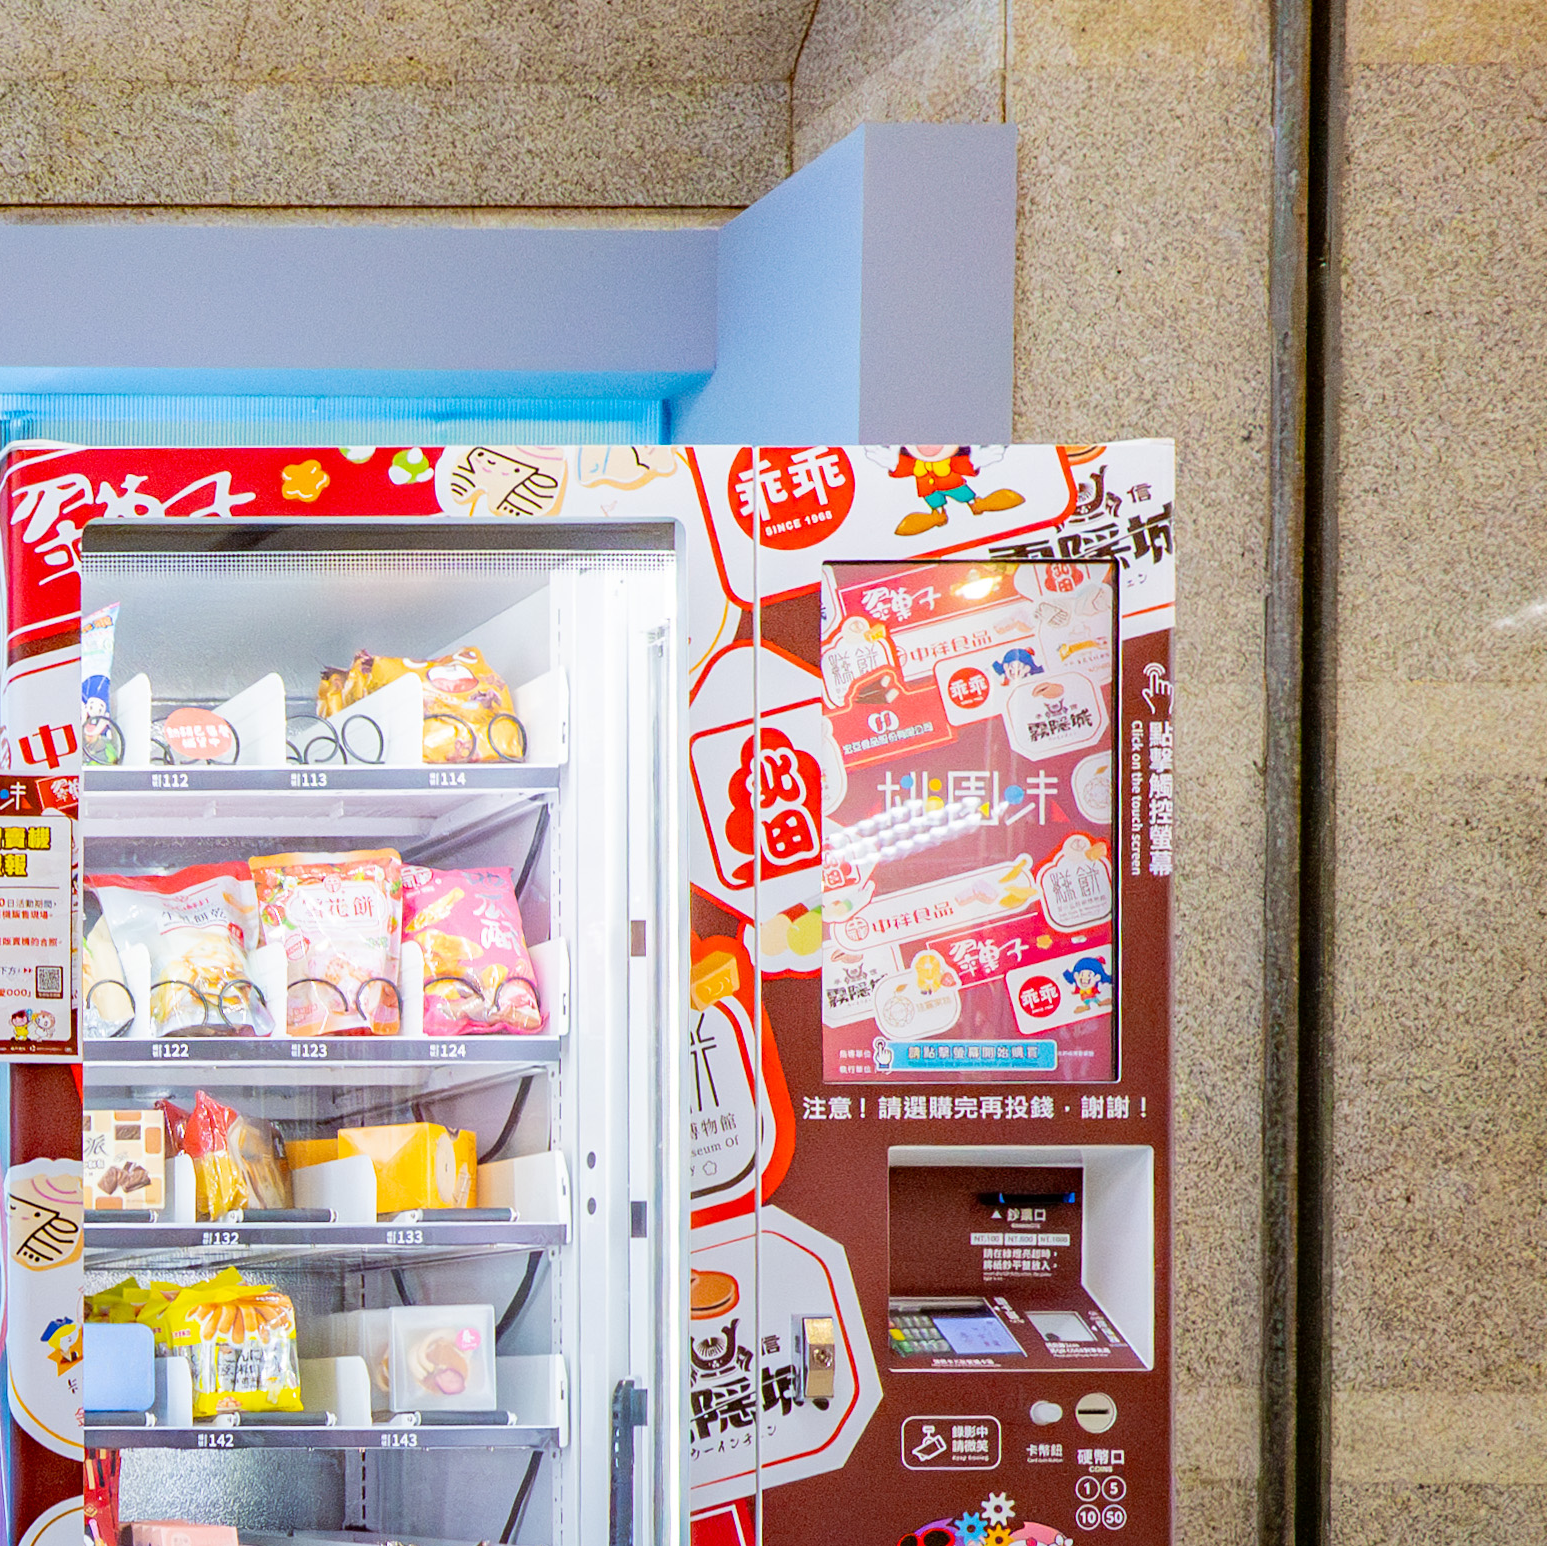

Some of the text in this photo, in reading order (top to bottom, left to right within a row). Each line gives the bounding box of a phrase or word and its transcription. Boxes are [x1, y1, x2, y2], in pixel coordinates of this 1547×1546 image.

[733, 448, 848, 521] 乖乖
[1127, 483, 1152, 504] 信
[765, 509, 833, 537] SINCE 1968
[909, 629, 993, 663] 中祥食品
[948, 679, 989, 701] 乖乖
[18, 723, 78, 770] 中
[161, 772, 189, 787] 112
[299, 772, 328, 787] 113
[438, 772, 467, 787] 114
[1130, 720, 1143, 876] Click on the touch screen
[1147, 720, 1174, 876] 點擊觸控螢幕
[872, 900, 955, 934] 中祥食品
[1019, 983, 1059, 1009] 乖乖
[162, 1043, 189, 1058] 122
[301, 1043, 328, 1058] 123
[439, 1043, 467, 1058] 124
[908, 1046, 1041, 1060] 請點擊螢幕開始購買
[212, 1230, 240, 1246] 132
[396, 1230, 424, 1246] 133
[207, 1432, 235, 1448] 142
[391, 1432, 419, 1448] 143
[952, 1425, 989, 1439] 錄影中
[952, 1439, 989, 1453] 請微笑
[1026, 1443, 1063, 1457] 卡幣鈕
[1076, 1448, 1125, 1465] 硬幣口
[1080, 1510, 1123, 1524] 10 50
